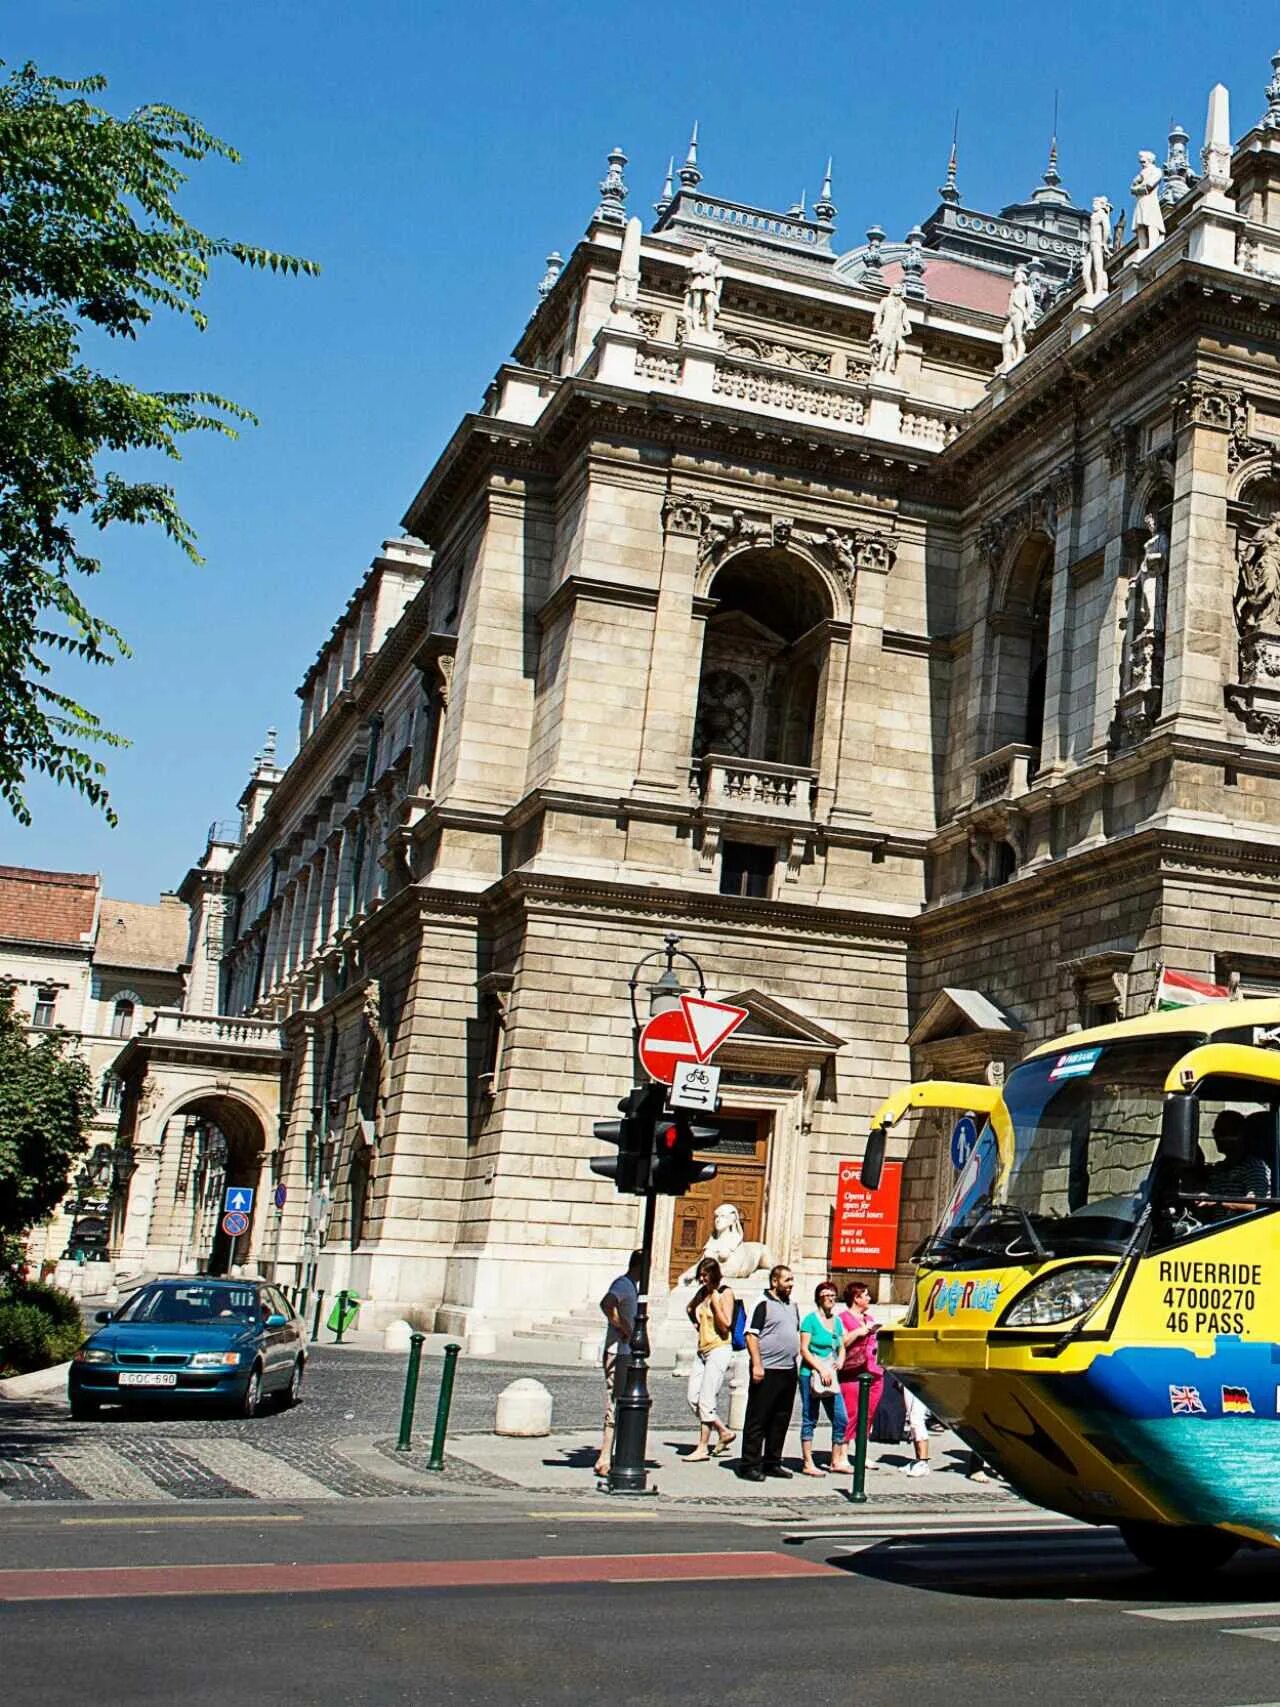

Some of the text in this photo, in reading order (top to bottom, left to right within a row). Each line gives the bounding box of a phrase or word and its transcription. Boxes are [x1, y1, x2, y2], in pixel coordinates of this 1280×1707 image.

[1160, 1260, 1262, 1285] RIVERRIDE
[924, 1278, 1000, 1322] RiverRide
[1163, 1287, 1256, 1310] 47000270
[1166, 1312, 1251, 1334] 46 PASS.
